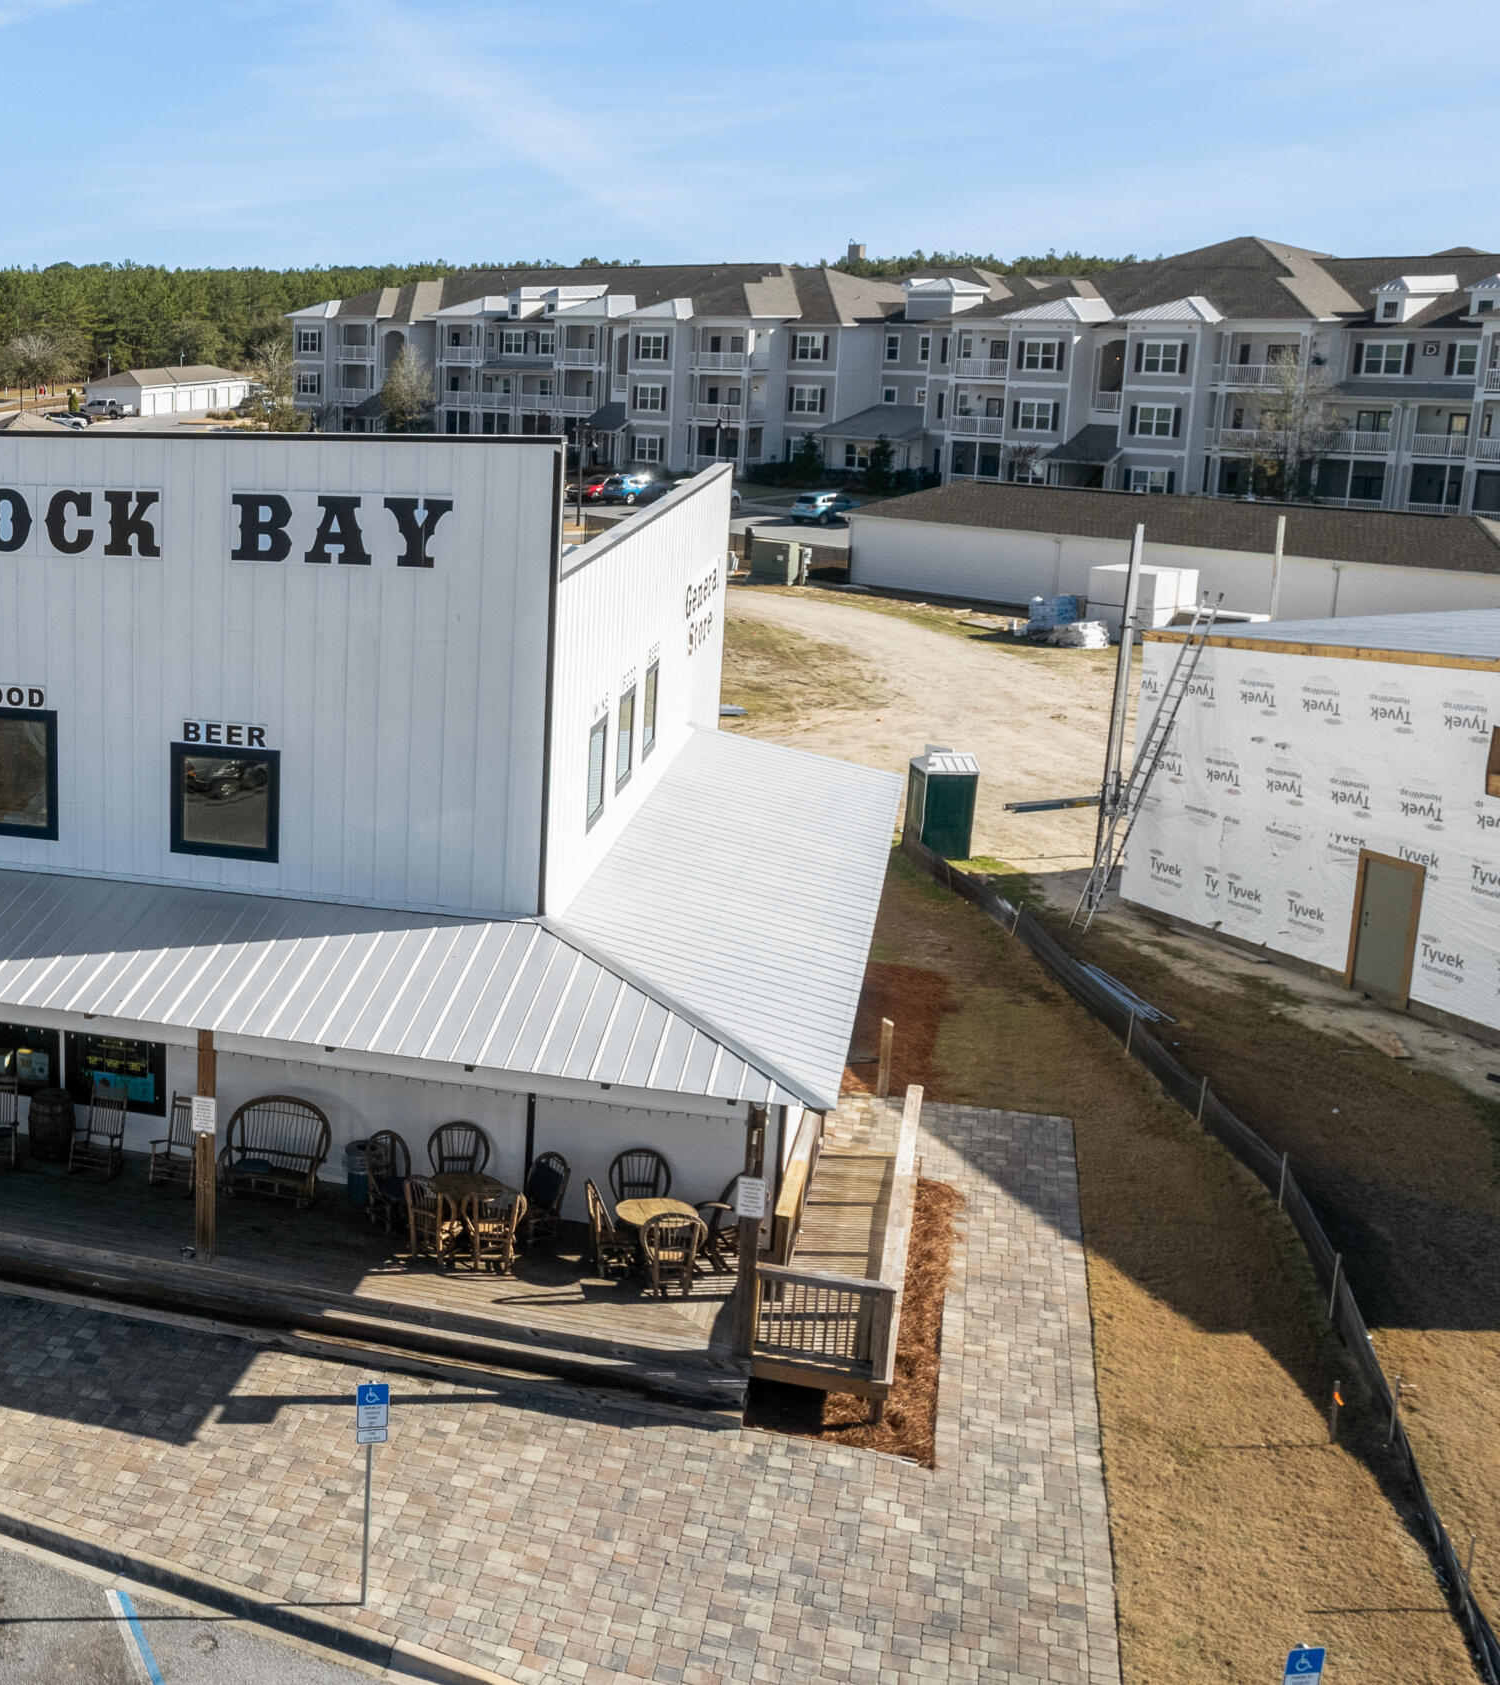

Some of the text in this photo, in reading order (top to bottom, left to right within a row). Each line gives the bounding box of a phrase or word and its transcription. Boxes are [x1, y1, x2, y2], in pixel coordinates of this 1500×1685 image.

[231, 493, 454, 568] BAY
[1142, 678, 1159, 693] Tyv
[1241, 690, 1277, 708] Tyvek
[1302, 699, 1341, 716] Tyvek
[1442, 701, 1488, 714] HomeWrap
[1370, 706, 1412, 725] Tyvek
[1444, 715, 1489, 734] Tyvek
[183, 721, 266, 748] BEER
[1156, 759, 1183, 776] Tyve
[1206, 768, 1241, 787] Tyvek
[1266, 779, 1303, 797] Tyvek
[1331, 790, 1370, 809] Tyvek
[1401, 801, 1443, 822] Tyvek
[1150, 856, 1182, 877] Tyvek
[1227, 880, 1262, 903] Tyvek
[1287, 898, 1325, 922] Tyvek
[1421, 943, 1465, 970] Tyvek
[1421, 961, 1465, 983] HomeWrap
